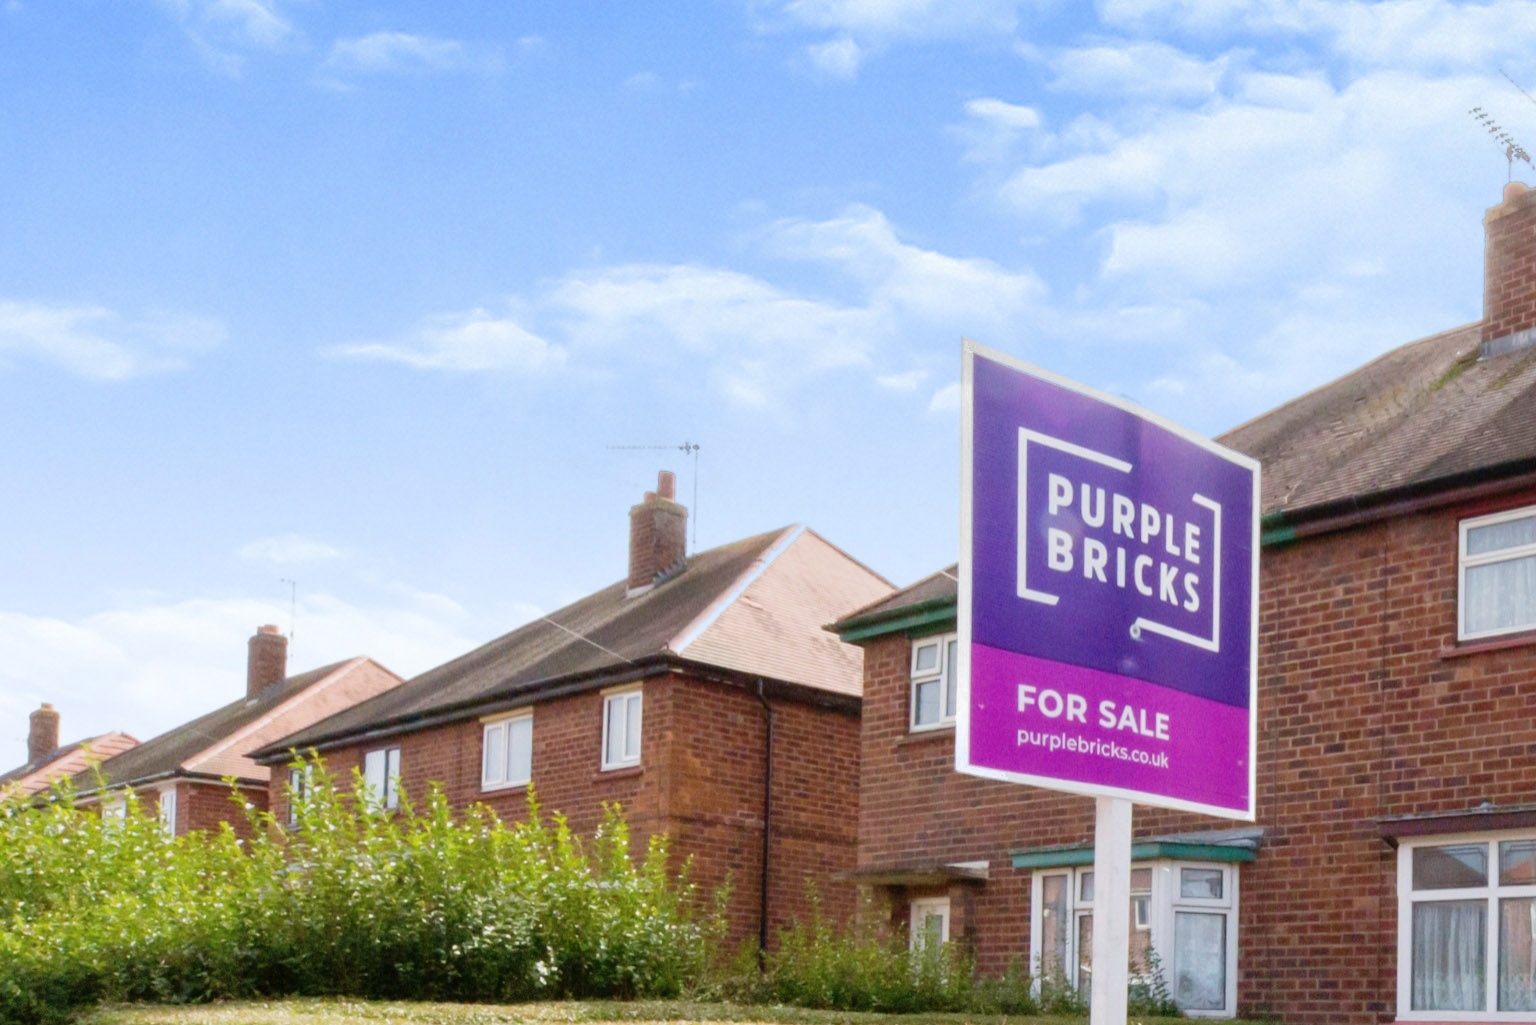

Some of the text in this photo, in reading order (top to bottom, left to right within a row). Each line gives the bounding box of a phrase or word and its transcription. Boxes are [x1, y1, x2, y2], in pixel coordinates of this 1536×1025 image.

[1048, 472, 1201, 564] PURPLE
[1047, 527, 1201, 612] BRICKS
[1017, 684, 1170, 740] FOR SALE
[1017, 729, 1169, 768] purplebricks.co.uk
